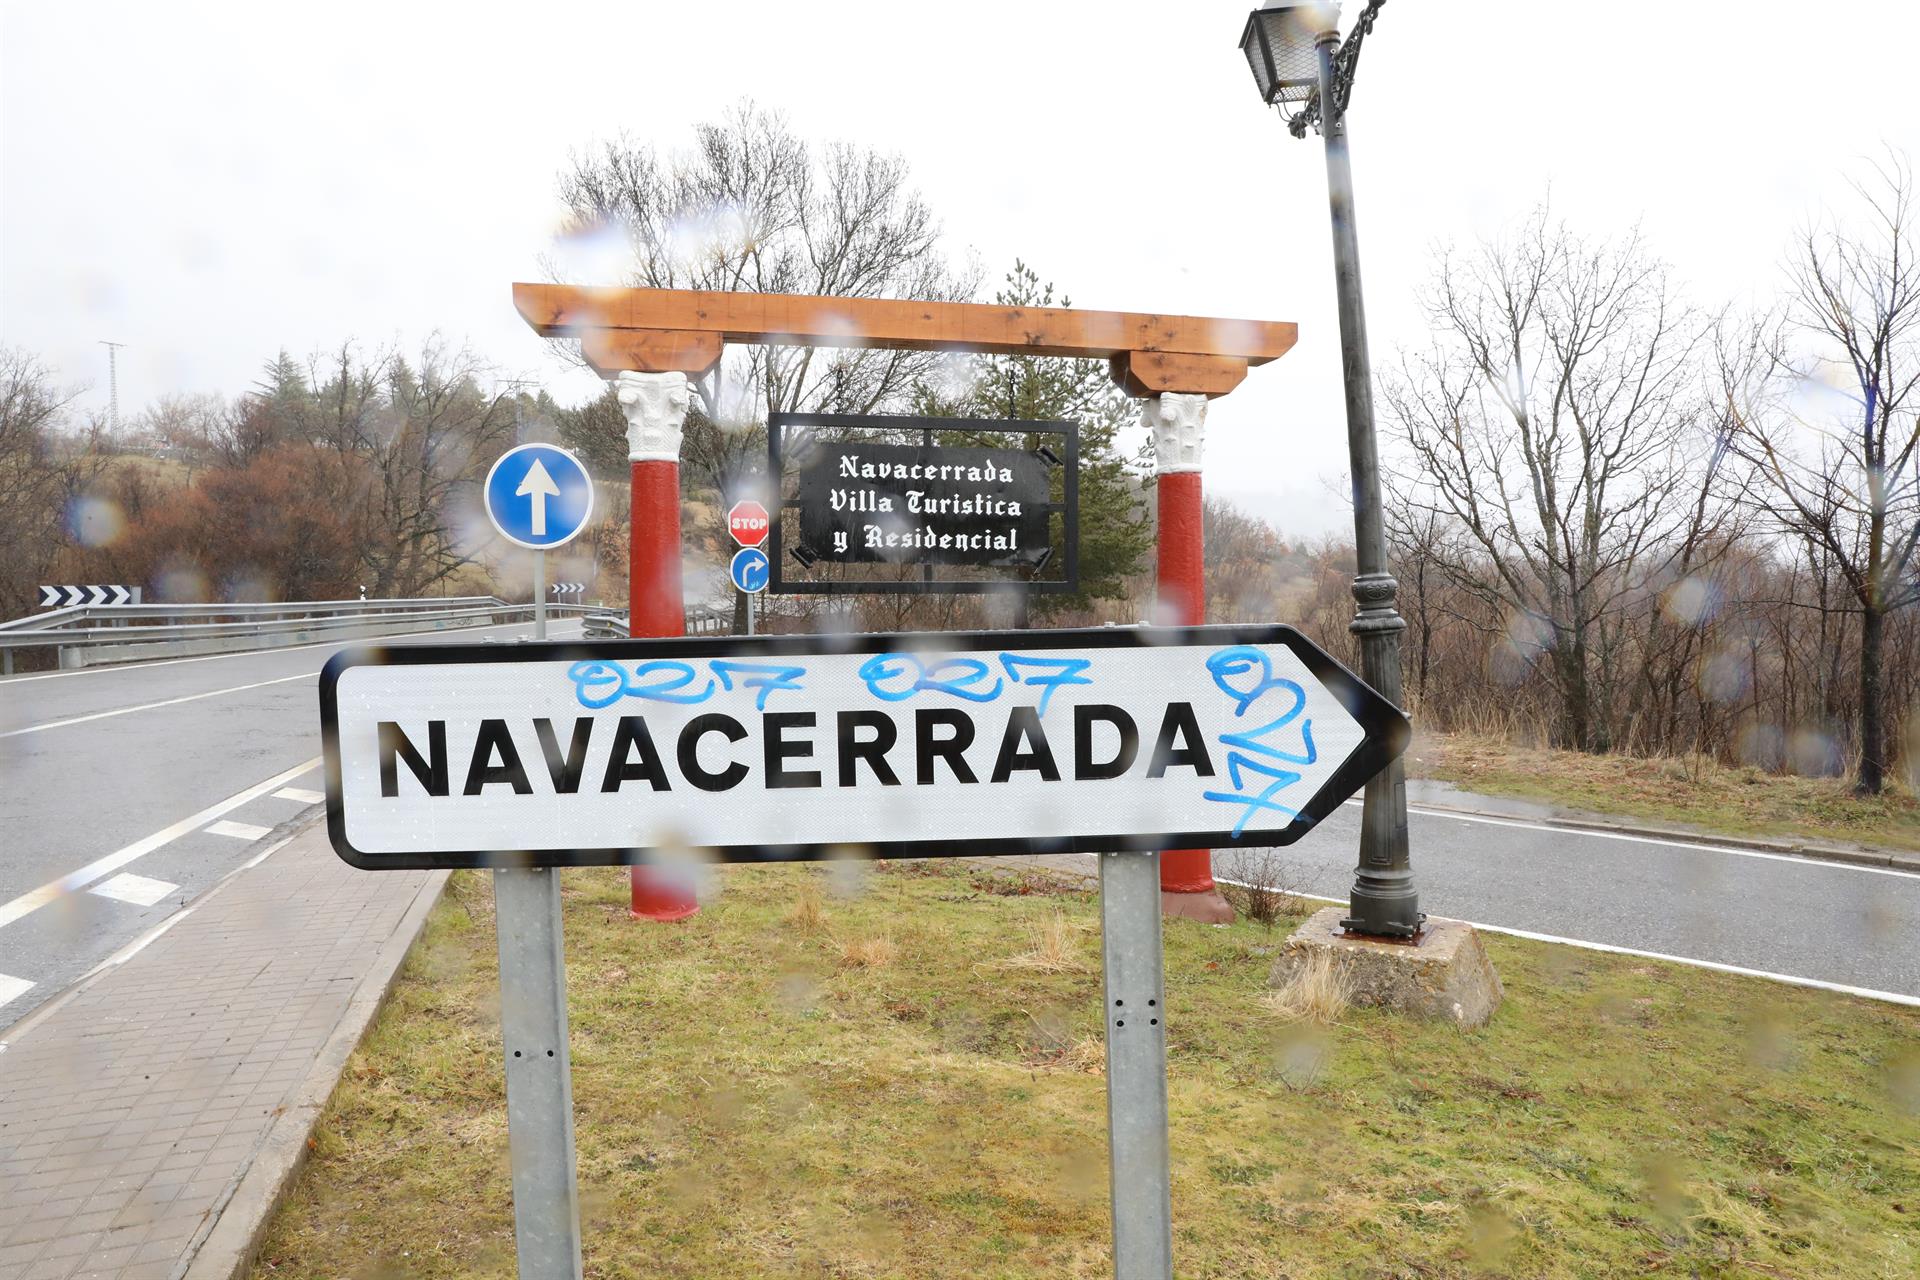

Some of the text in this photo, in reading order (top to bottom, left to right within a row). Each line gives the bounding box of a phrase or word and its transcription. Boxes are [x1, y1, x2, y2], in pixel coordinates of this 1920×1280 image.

[839, 455, 1014, 483] Navacerrada
[829, 488, 894, 512] Villa
[732, 517, 767, 530] STOP
[833, 524, 1017, 553] y Residencial
[376, 701, 1217, 799] NAVACERRADA
